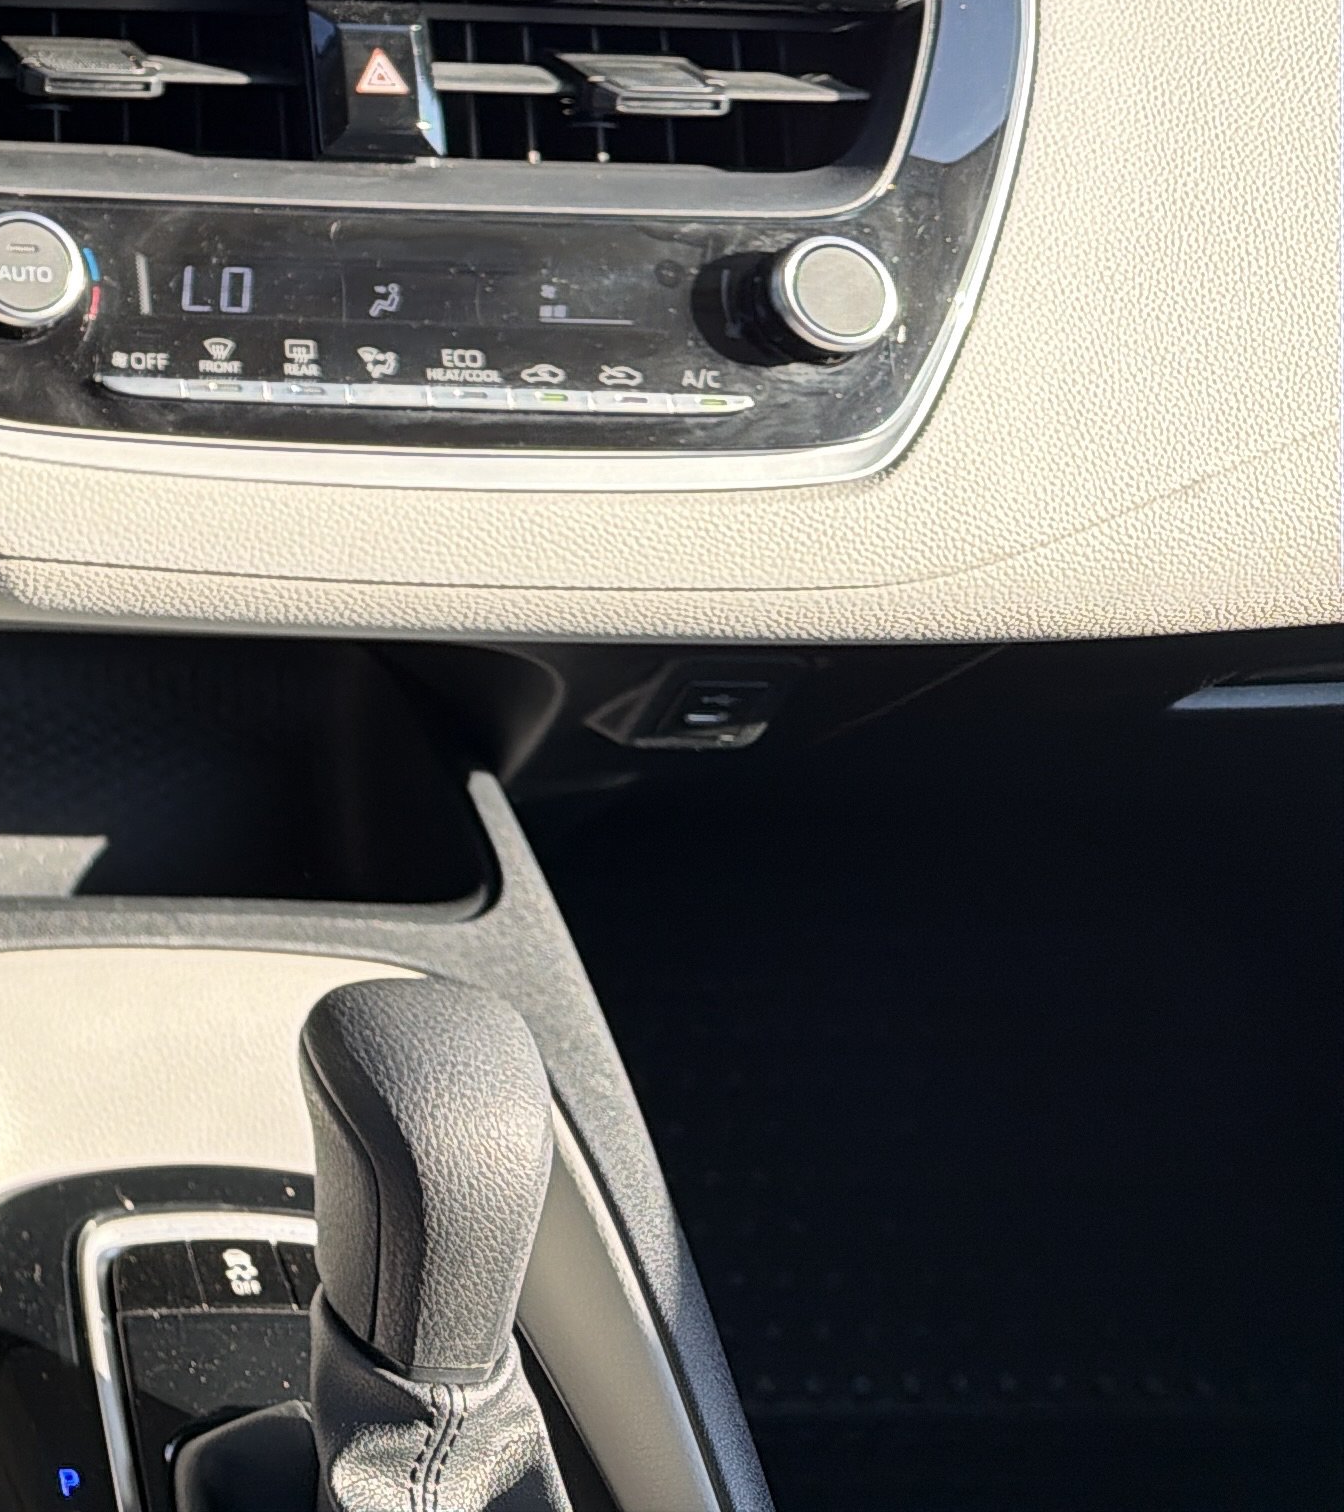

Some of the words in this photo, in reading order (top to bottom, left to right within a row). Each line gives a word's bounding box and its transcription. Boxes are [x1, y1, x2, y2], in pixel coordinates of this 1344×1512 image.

[181, 264, 254, 313] LO
[130, 351, 170, 371] OFF
[198, 359, 243, 374] FRONT
[440, 348, 487, 369] ECO
[283, 362, 324, 377] REAR
[426, 367, 504, 384] HEAT/COOL
[681, 368, 723, 389] A/C
[58, 1468, 80, 1497] P
